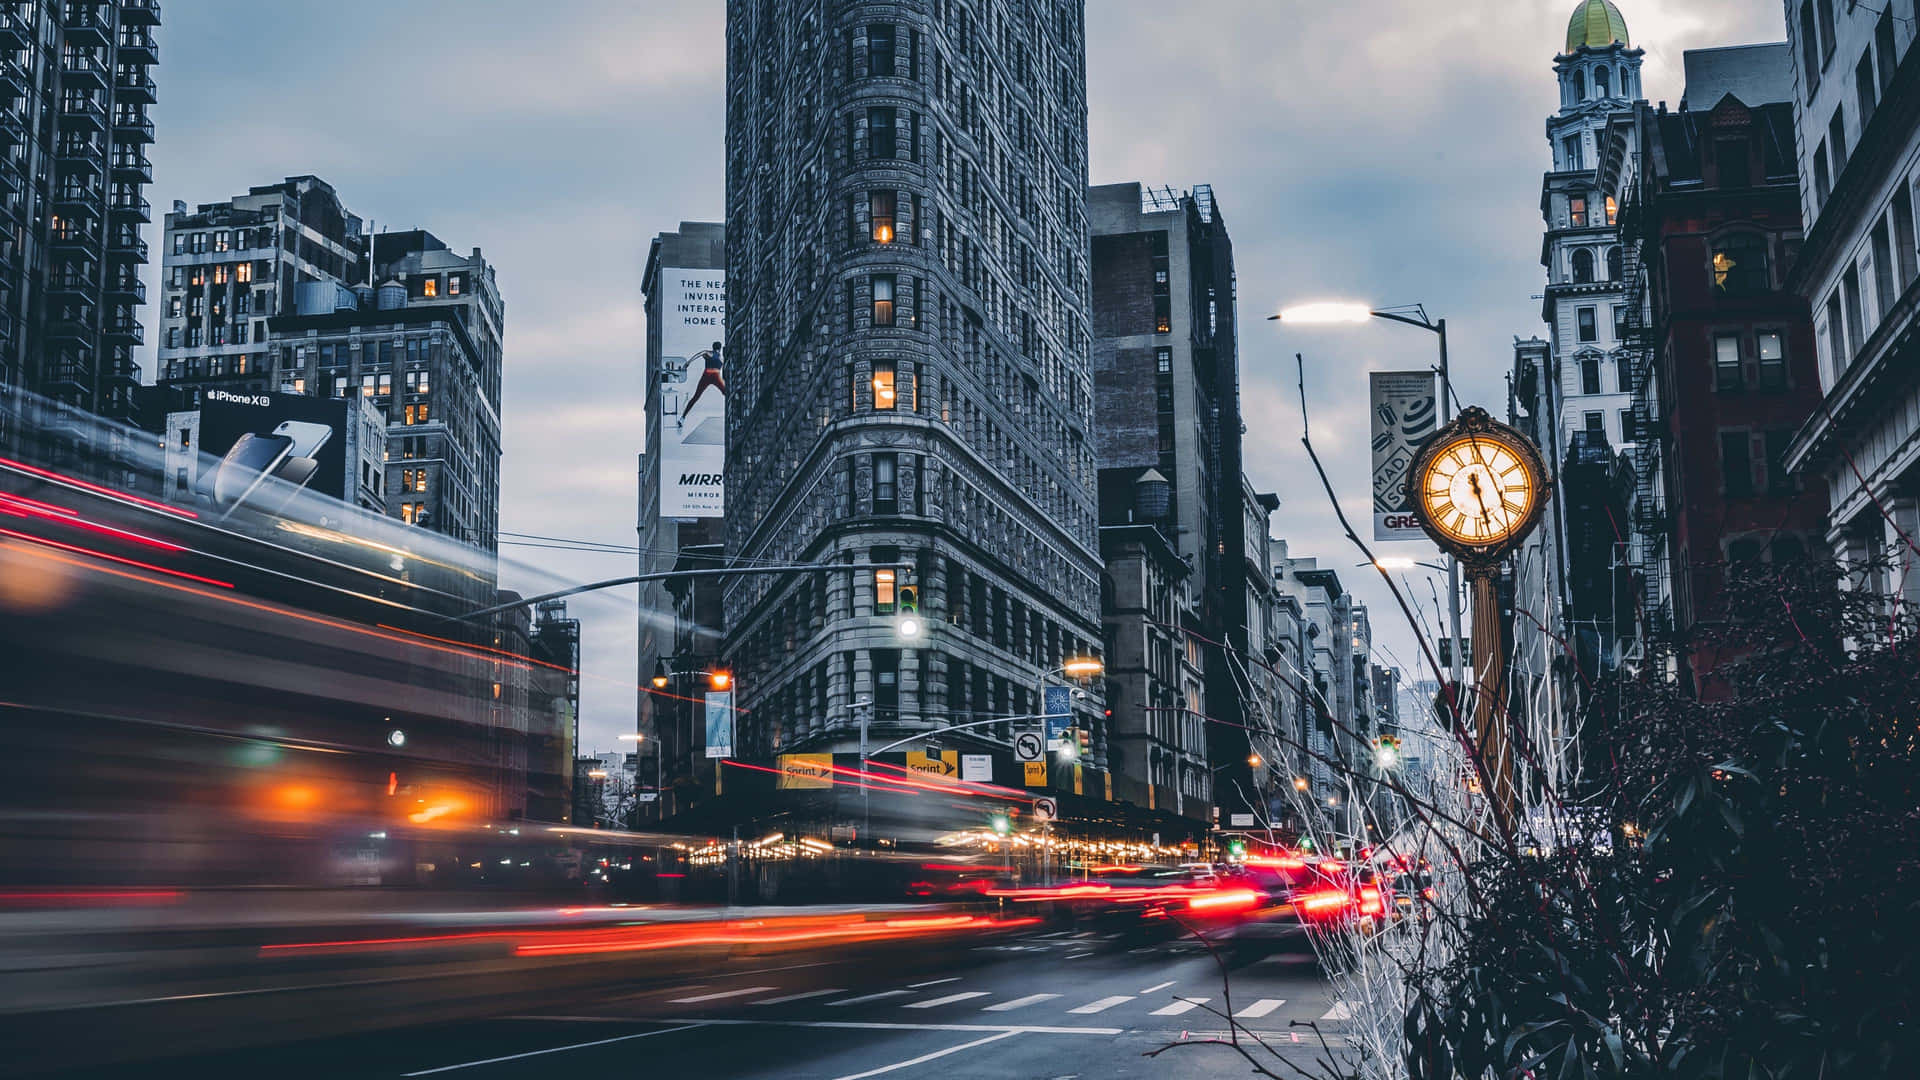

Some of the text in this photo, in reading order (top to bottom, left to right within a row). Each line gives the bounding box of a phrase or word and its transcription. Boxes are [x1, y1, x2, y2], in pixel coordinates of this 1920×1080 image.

[681, 280, 702, 288] THE
[216, 391, 250, 404] iPhone
[679, 474, 722, 486] MIRR
[786, 766, 816, 779] Sprint
[910, 764, 940, 777] Sprint
